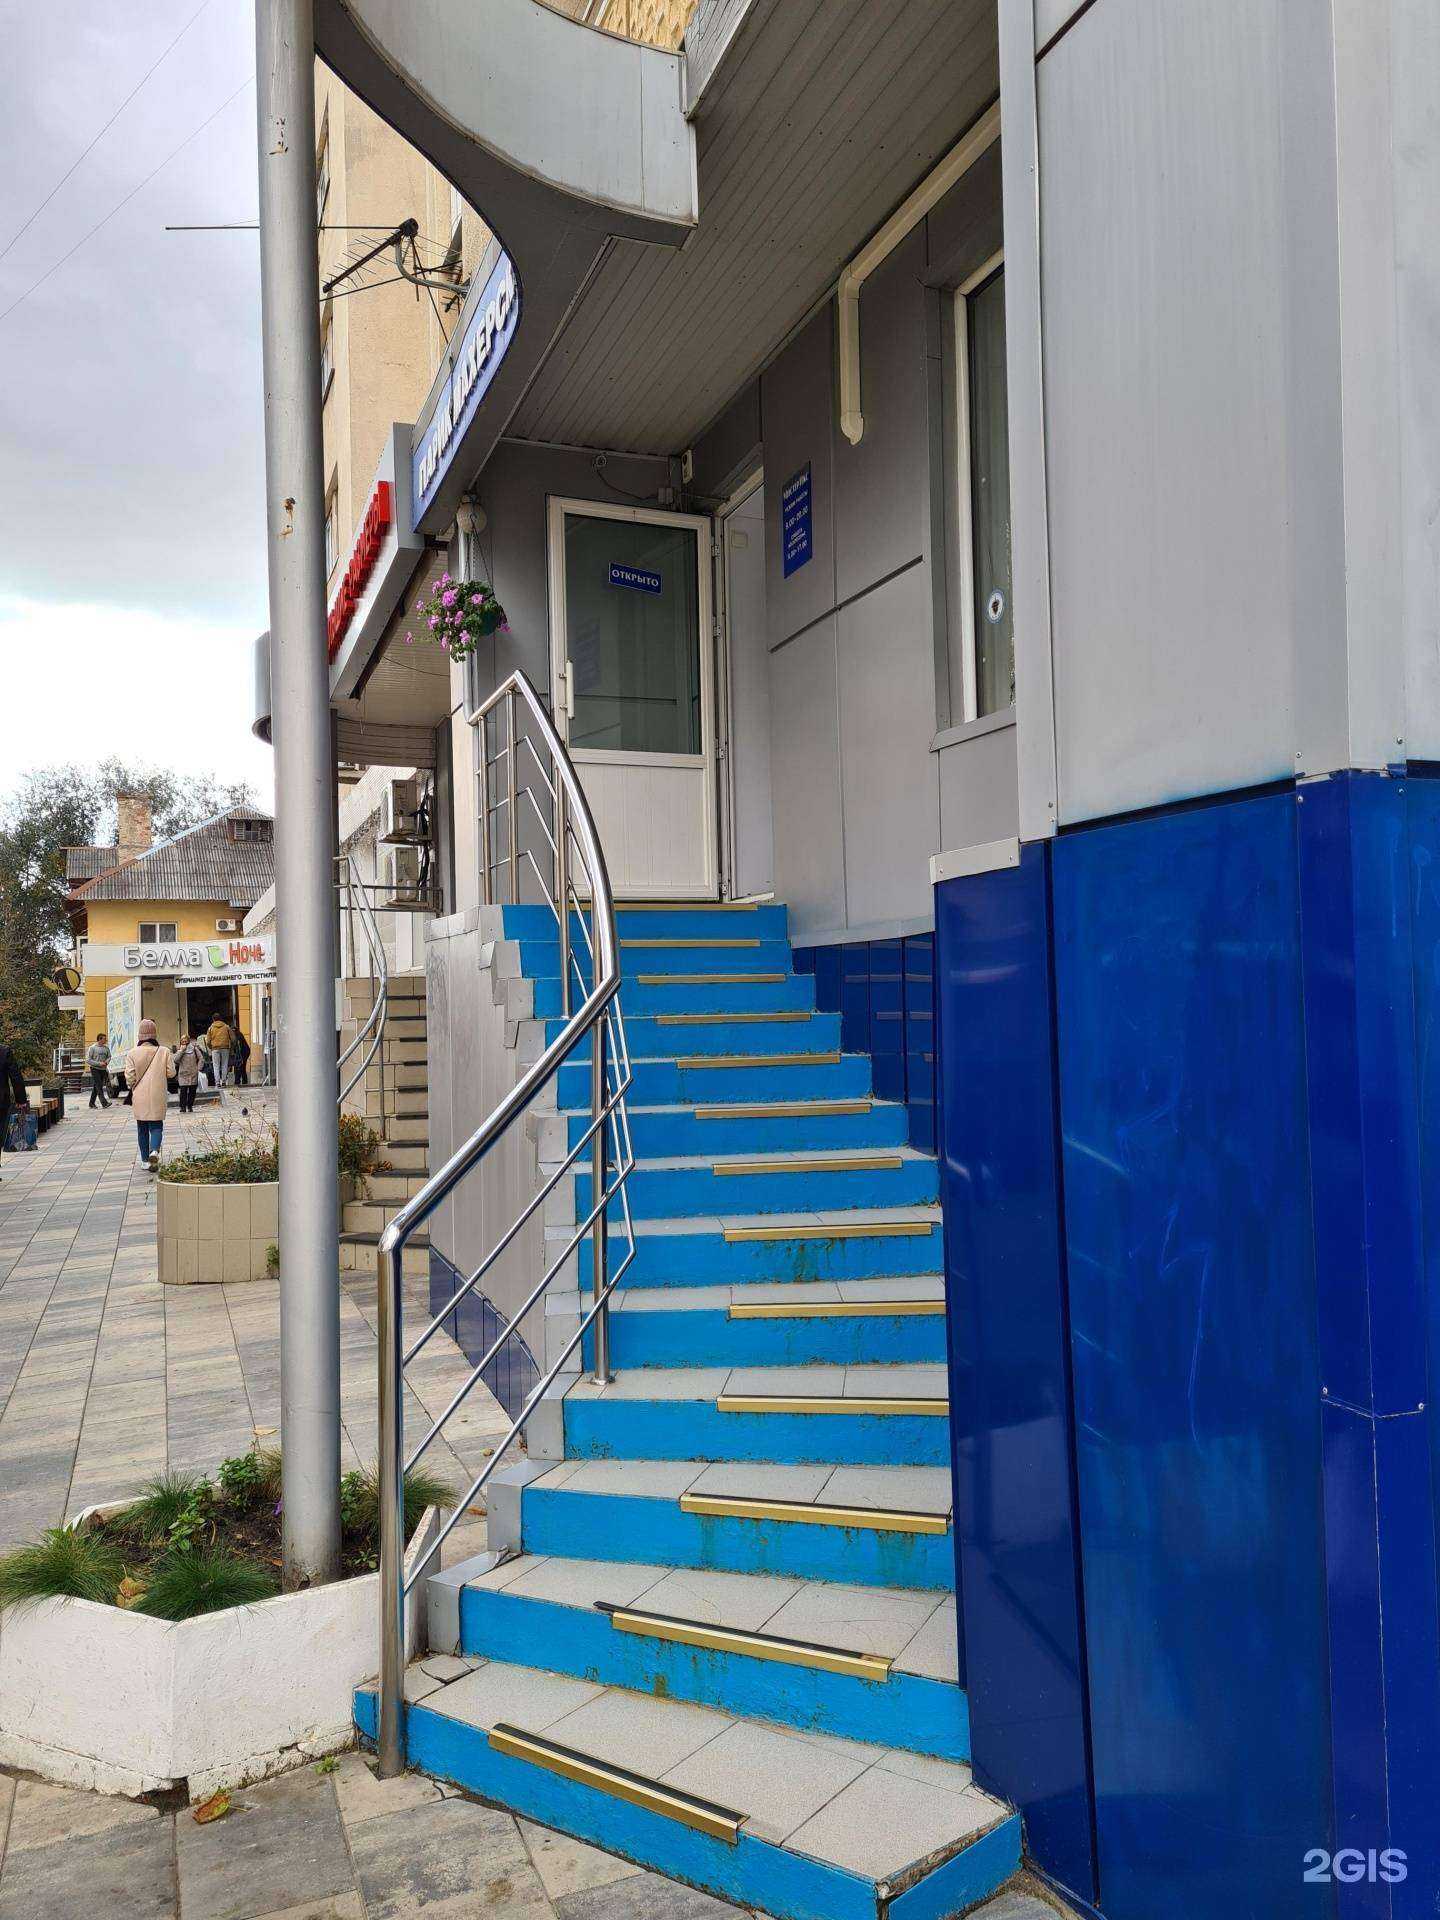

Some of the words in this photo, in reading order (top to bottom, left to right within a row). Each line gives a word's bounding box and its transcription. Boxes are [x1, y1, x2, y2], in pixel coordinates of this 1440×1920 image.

[611, 569, 659, 587] ОТКРЫТО
[123, 946, 203, 969] Белла
[175, 976, 206, 984] СУПЕРМАРКЕТ
[207, 974, 242, 983] ДОМАШНЕГО
